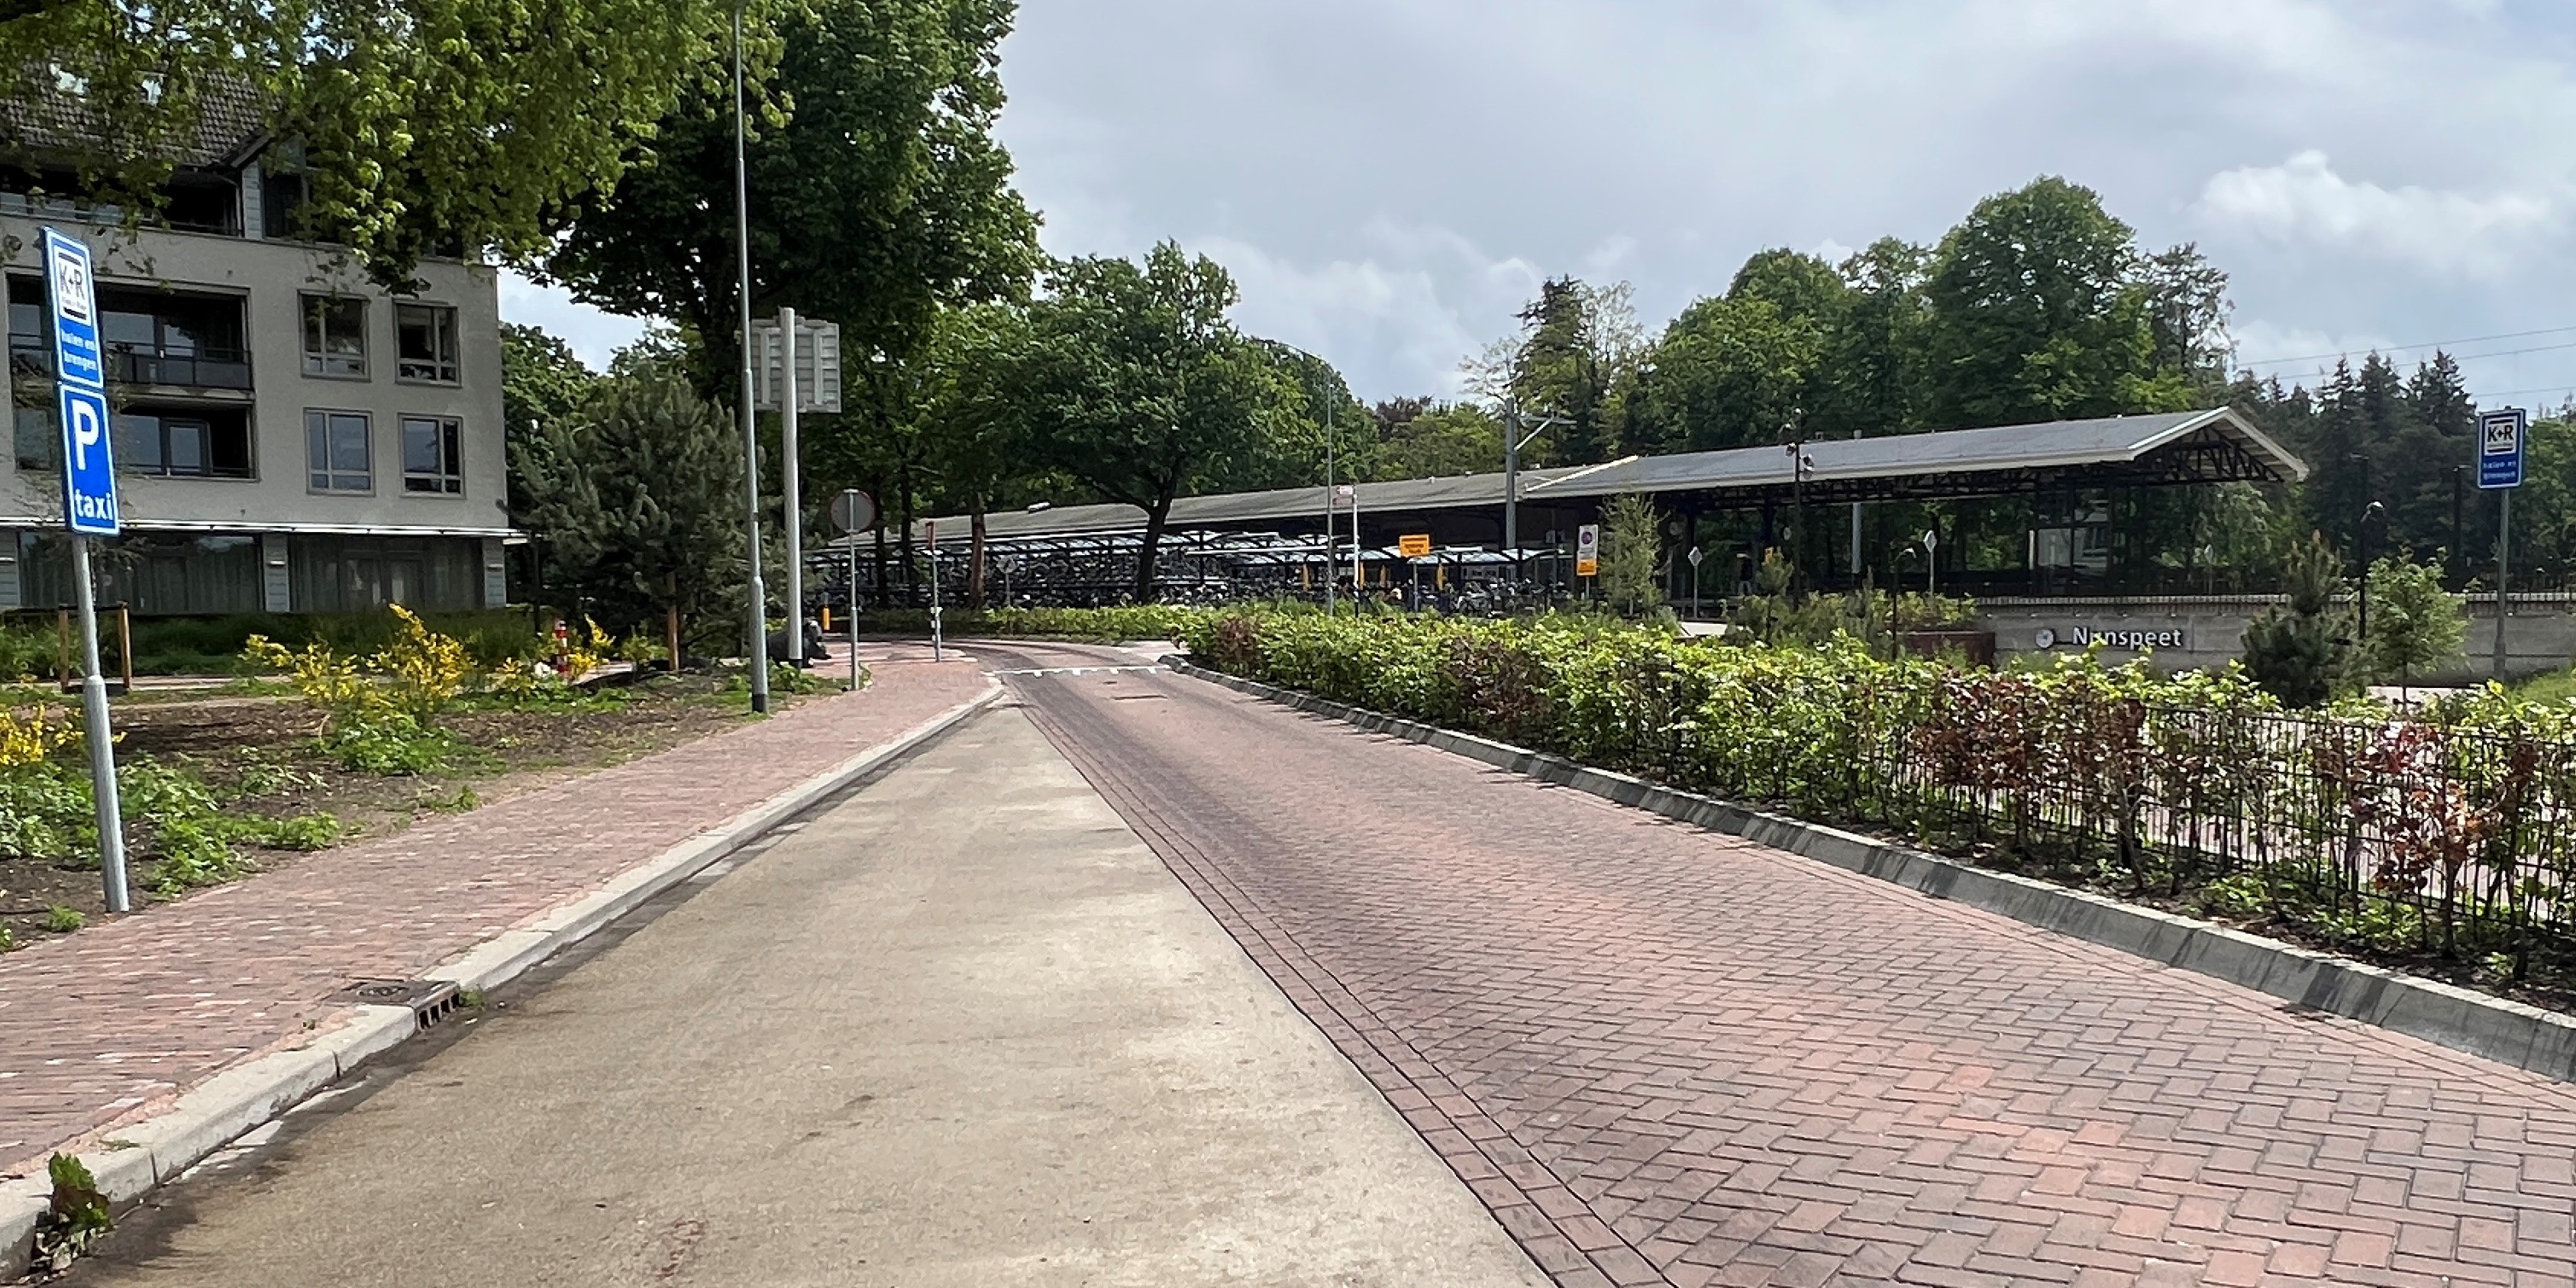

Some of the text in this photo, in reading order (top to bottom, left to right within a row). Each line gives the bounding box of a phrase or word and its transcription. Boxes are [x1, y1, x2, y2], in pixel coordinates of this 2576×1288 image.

[59, 263, 86, 300] K+R
[72, 399, 99, 470] P
[2487, 424, 2513, 442] K+R
[75, 489, 113, 521] taxi
